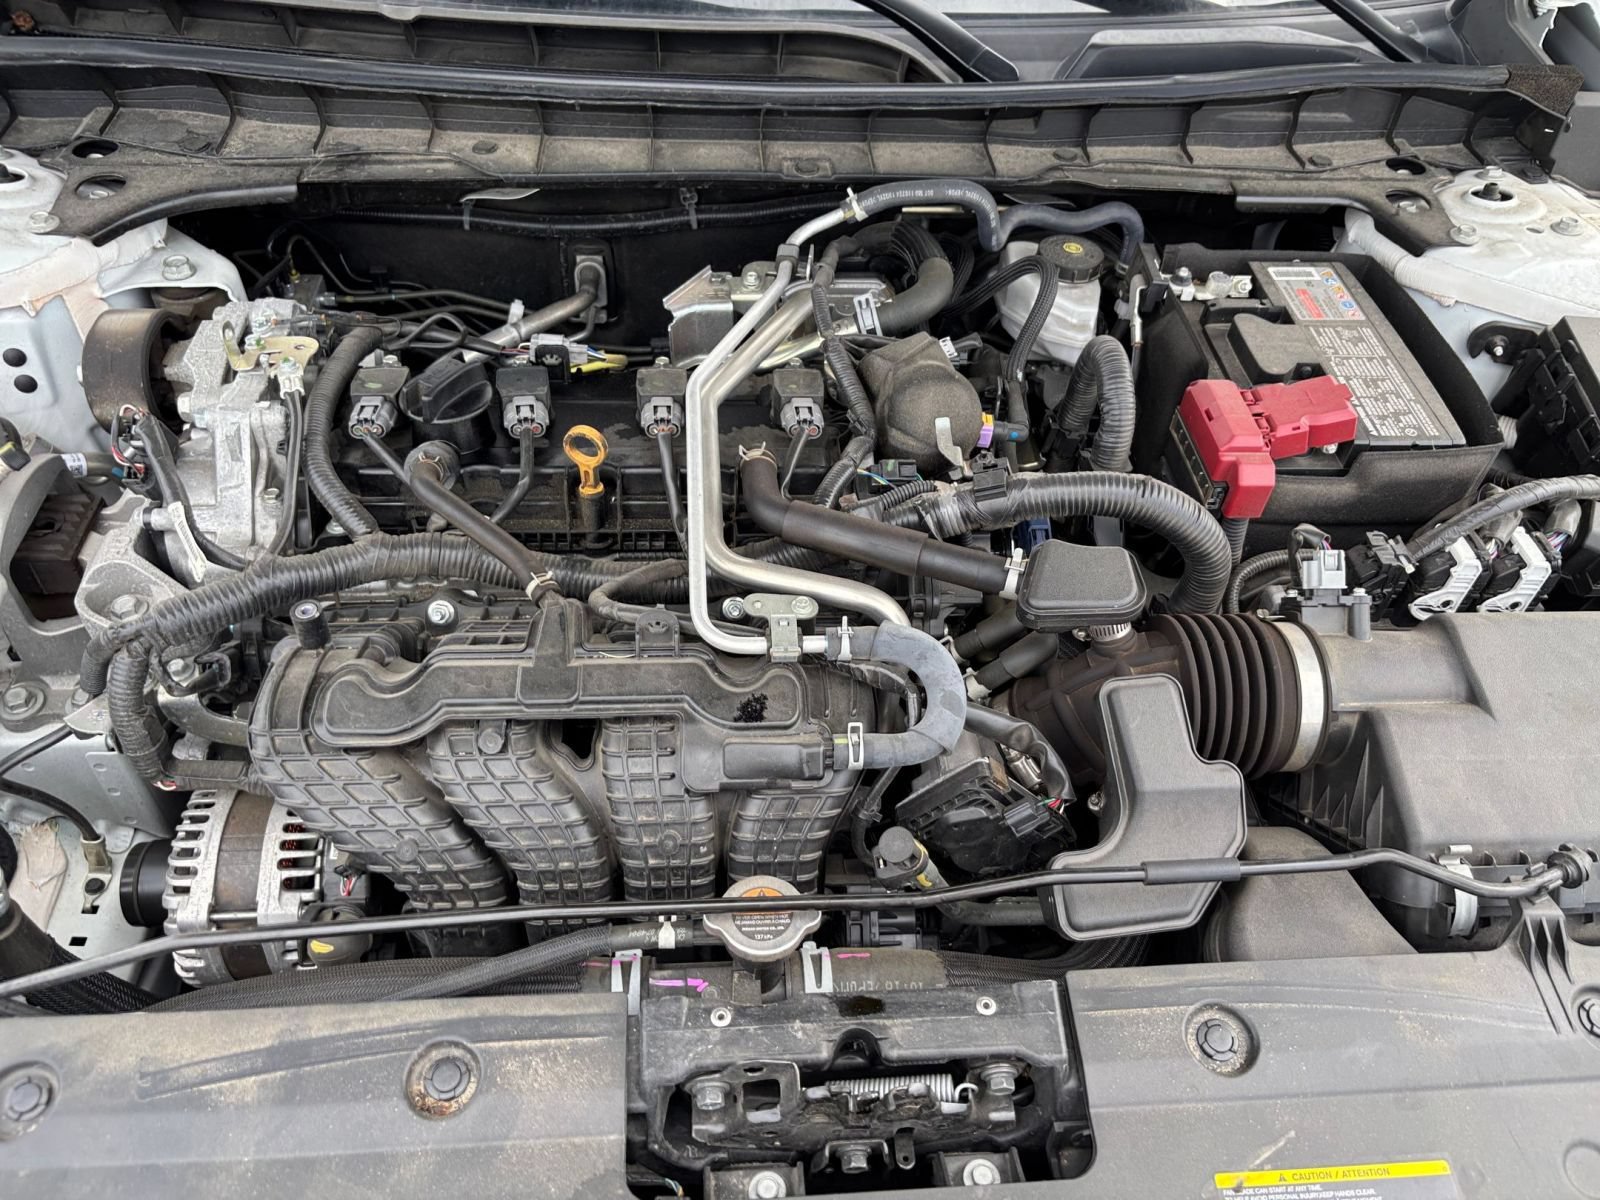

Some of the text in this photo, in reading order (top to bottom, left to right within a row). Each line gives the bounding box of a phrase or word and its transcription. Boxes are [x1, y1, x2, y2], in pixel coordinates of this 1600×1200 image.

[1291, 1170, 1332, 1181] CAUTION
[1342, 1167, 1391, 1179] ATTENTION
[1334, 1189, 1355, 1197] HANDS
